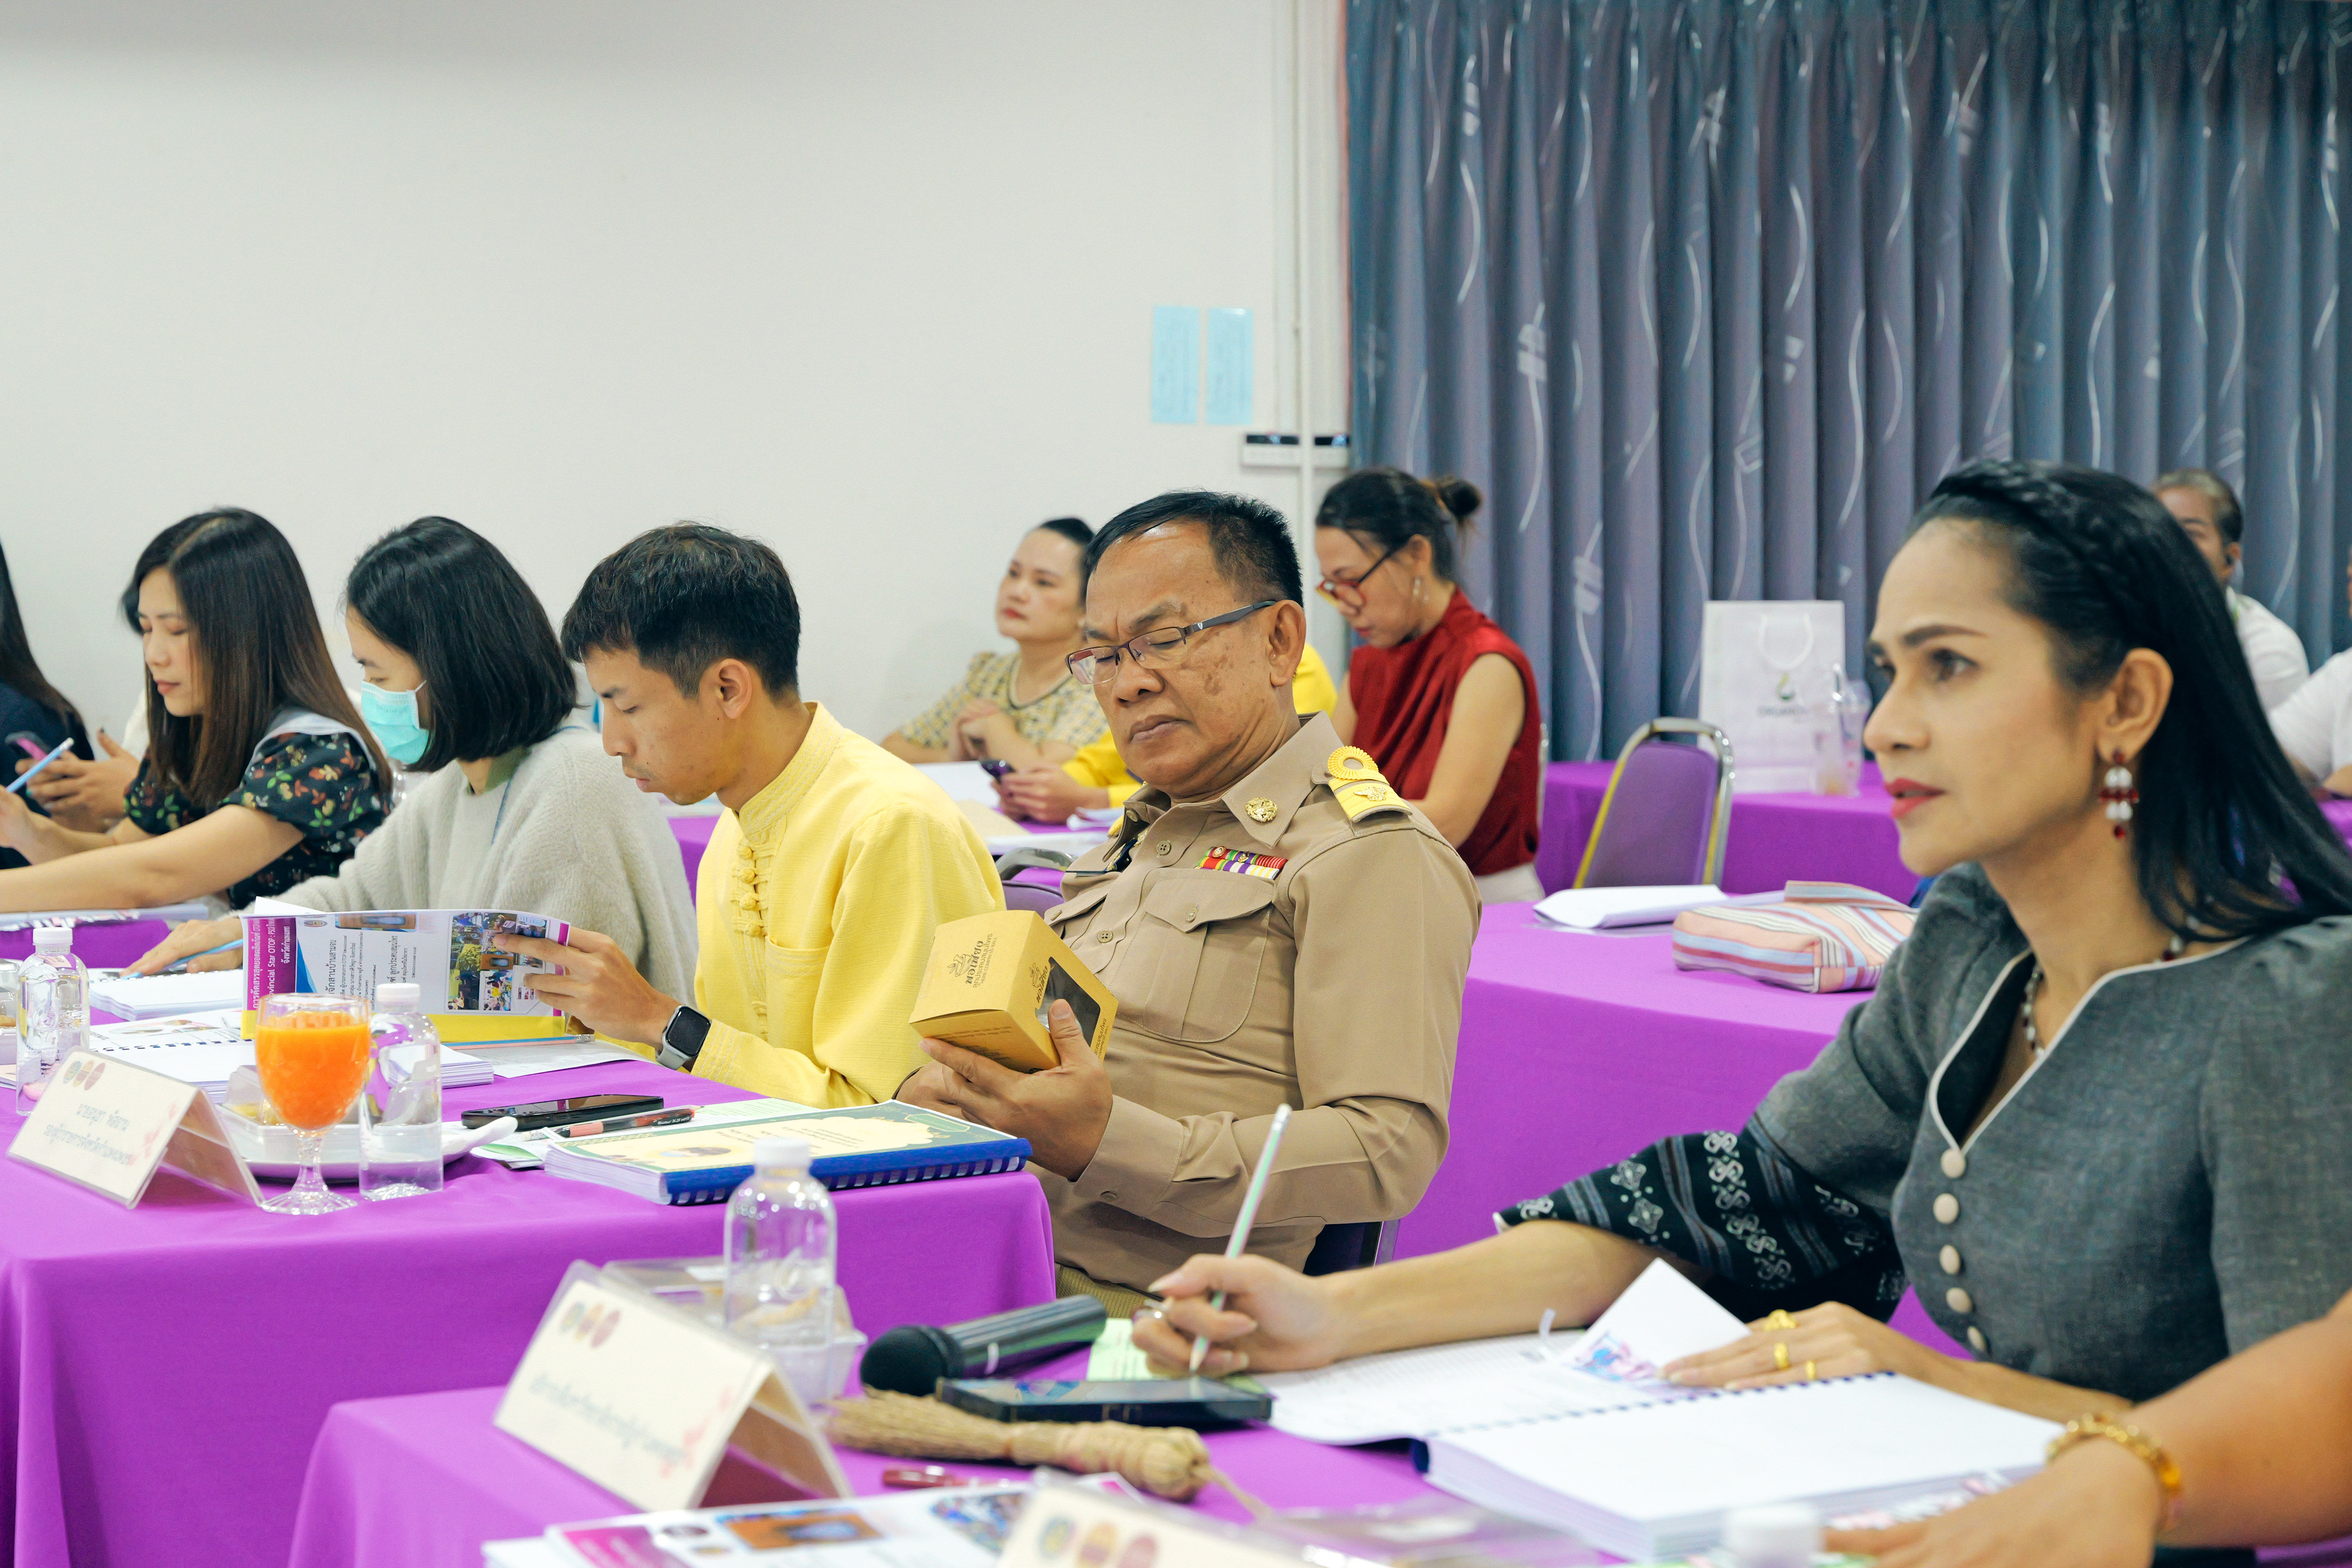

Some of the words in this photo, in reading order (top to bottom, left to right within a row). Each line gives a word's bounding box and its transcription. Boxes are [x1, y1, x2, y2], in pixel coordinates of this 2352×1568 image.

[325, 940, 336, 994] จักสานบ้านสามจบ
[388, 936, 400, 975] ลูกประคบสมุนไพร
[965, 940, 984, 984] พอเพียง
[973, 933, 994, 988] ลูกประคบสมุนไพร
[984, 947, 995, 971] COMPRESS
[1094, 1018, 1107, 1055] ระคบสมุนไพร
